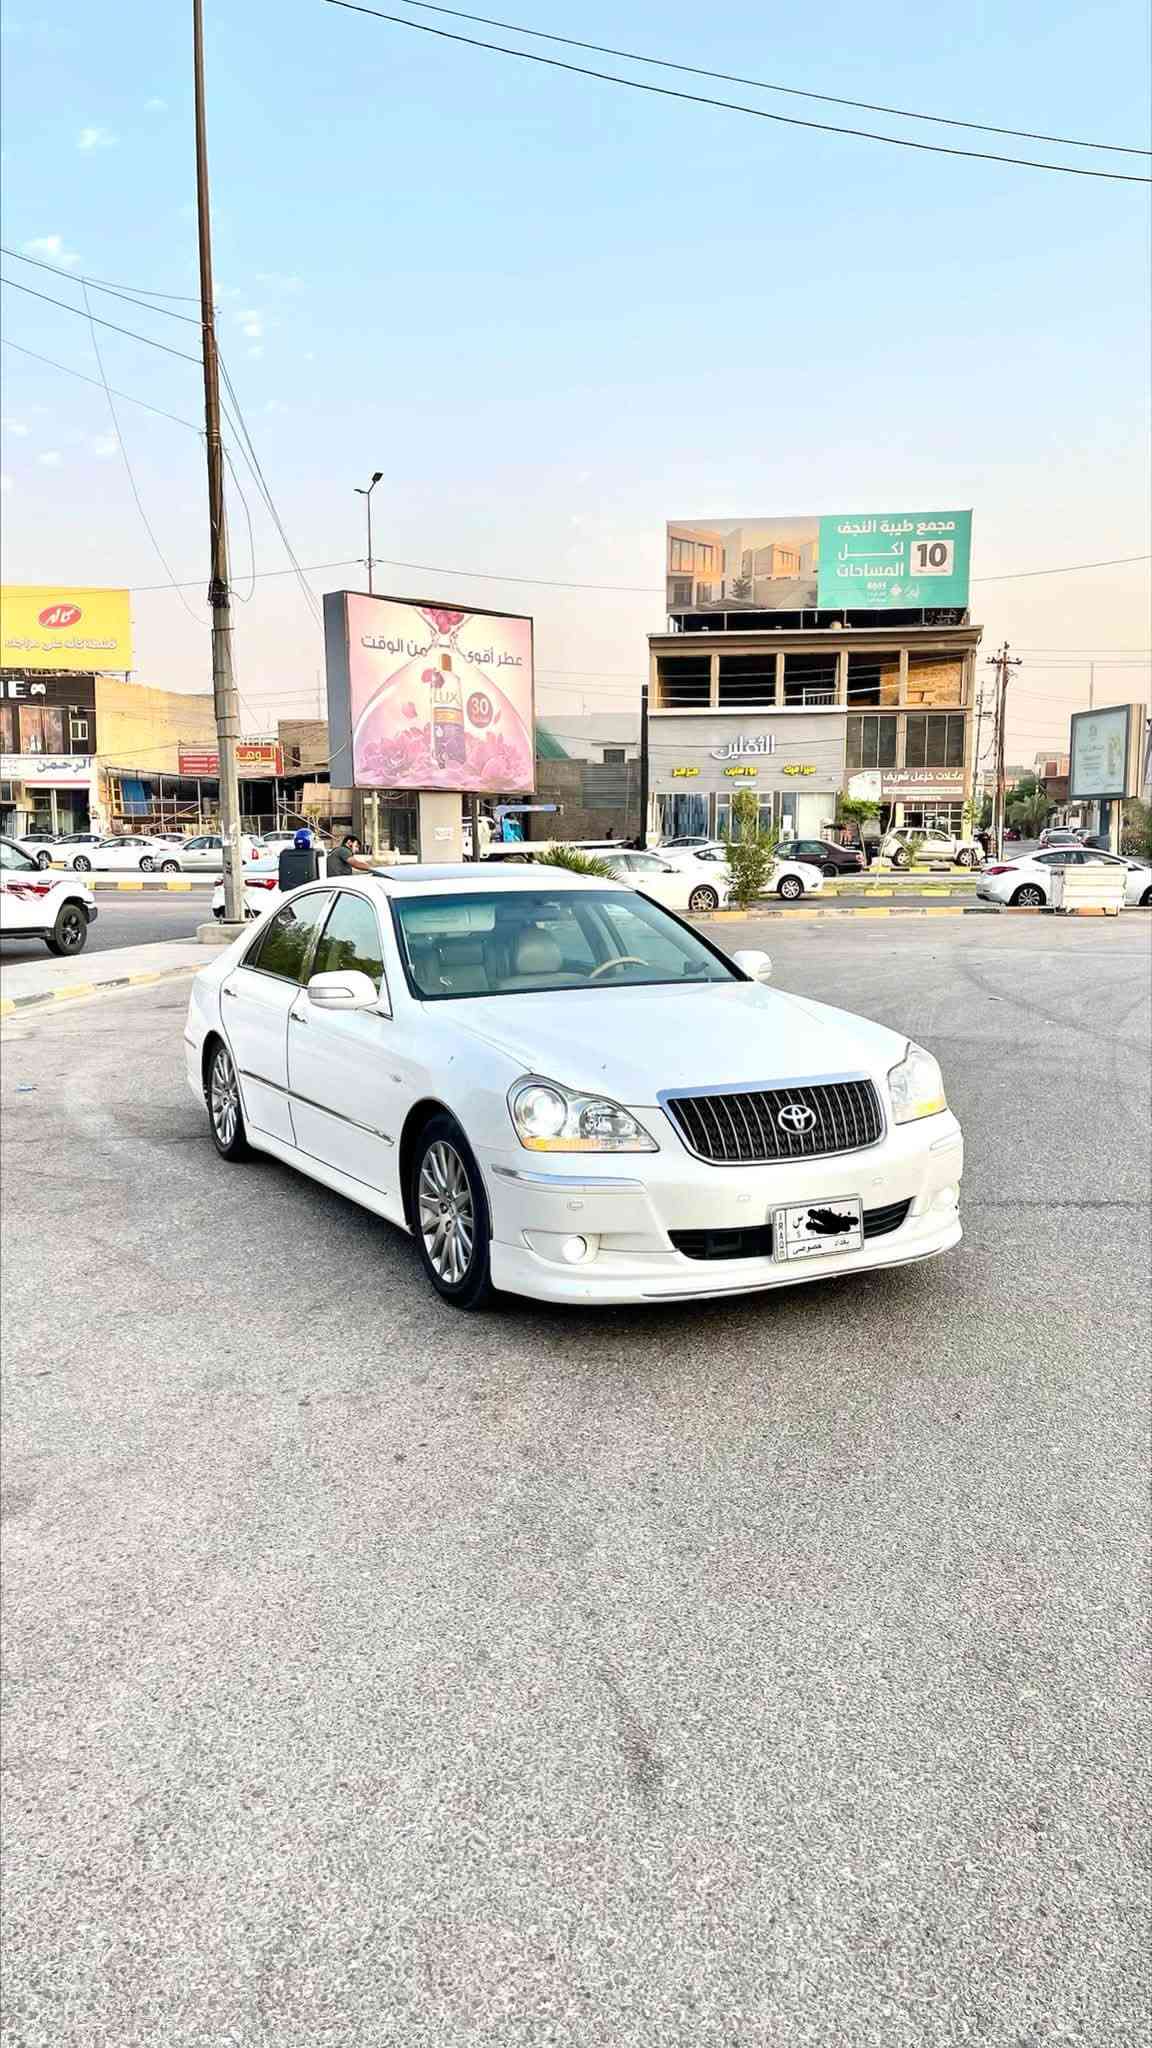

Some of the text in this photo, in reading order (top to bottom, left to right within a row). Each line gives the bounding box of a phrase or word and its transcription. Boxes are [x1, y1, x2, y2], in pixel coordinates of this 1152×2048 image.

[837, 519, 956, 536] مجمع طيبة النجف
[917, 543, 948, 567] 10
[836, 562, 904, 577] المساحات
[361, 635, 523, 667] عطر أقوى من الوقت
[434, 689, 460, 704] LUX
[471, 697, 489, 713] 30
[711, 735, 775, 760] الثقلين
[37, 757, 92, 774] الرحمن
